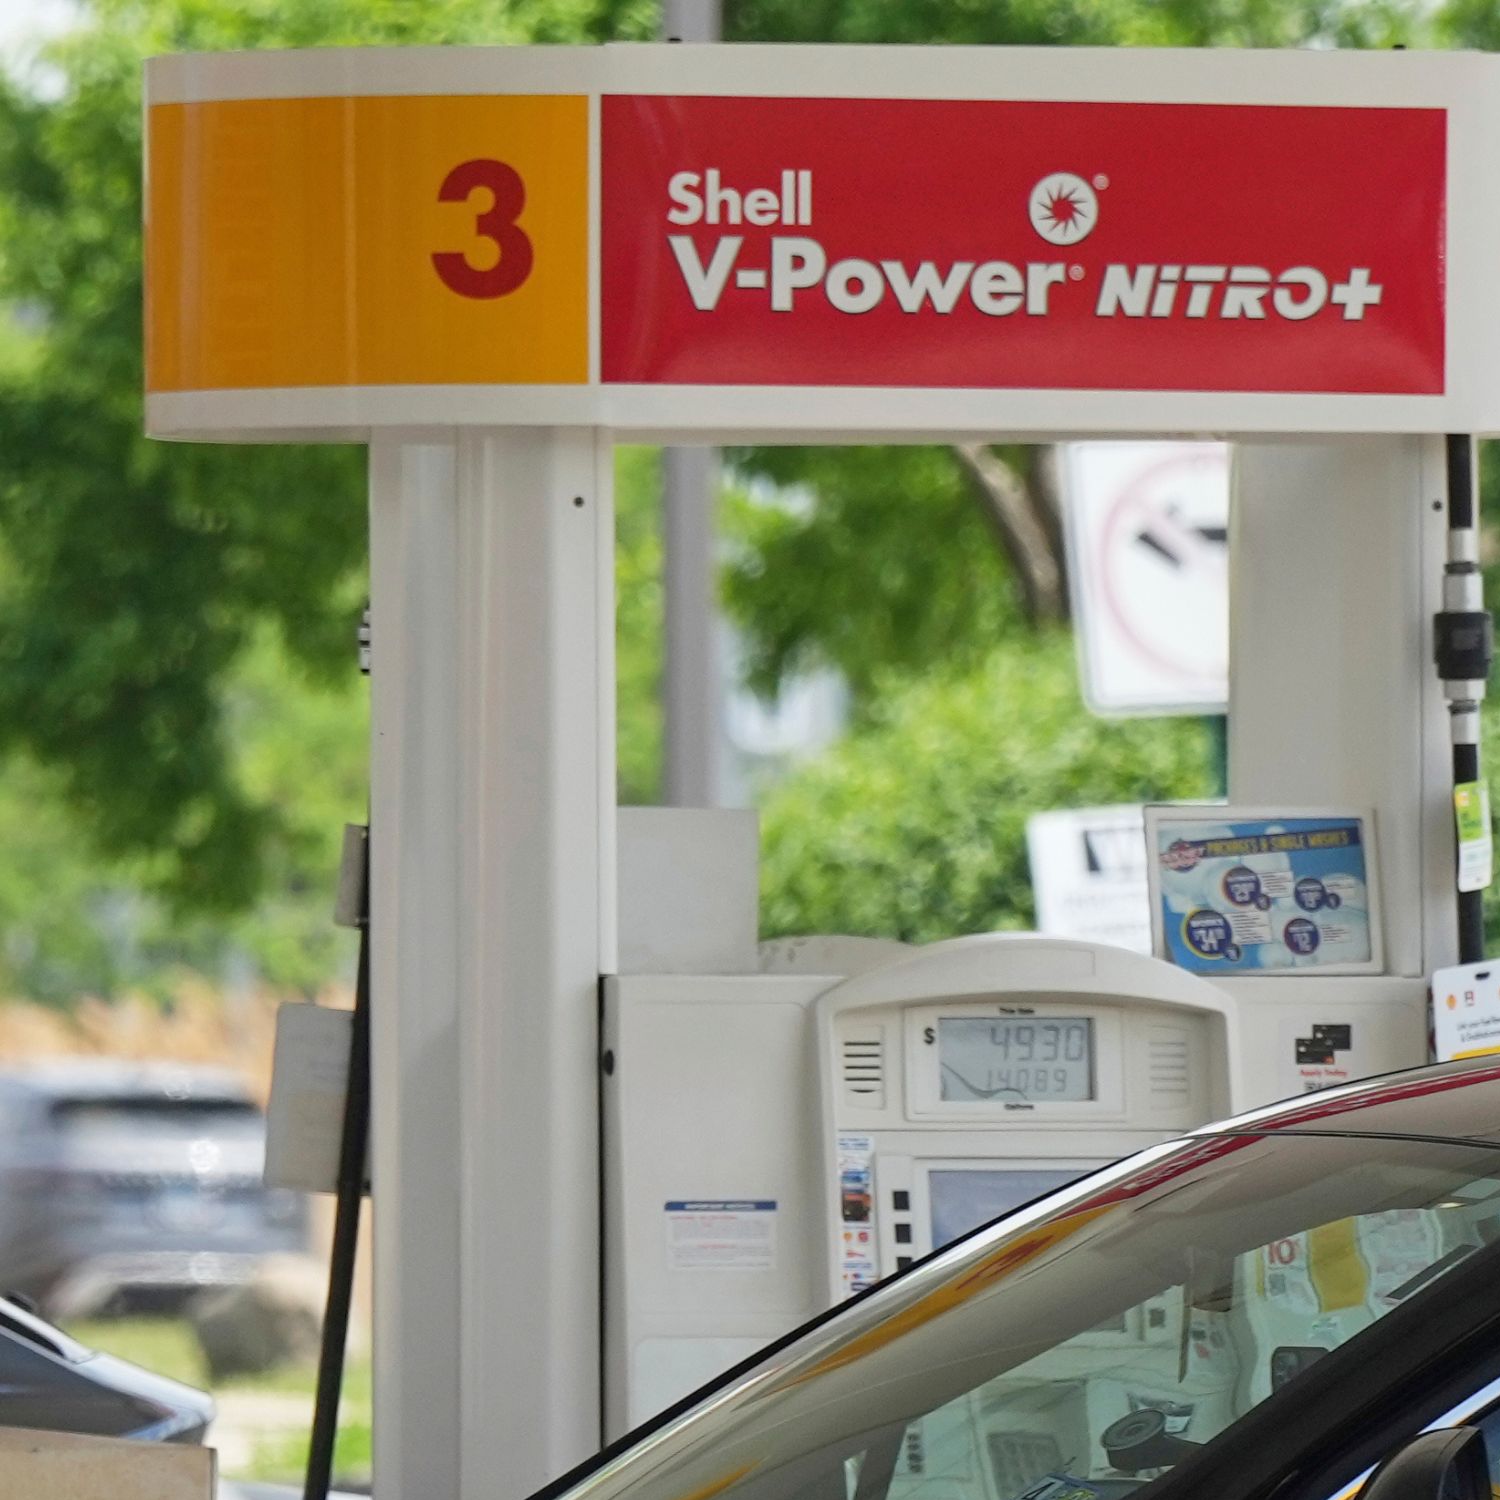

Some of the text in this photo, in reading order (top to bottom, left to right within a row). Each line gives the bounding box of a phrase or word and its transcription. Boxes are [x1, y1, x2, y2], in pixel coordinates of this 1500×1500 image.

[431, 158, 534, 300] 3
[667, 169, 812, 226] Shell
[666, 235, 1066, 316] V-Power
[923, 1027, 936, 1045] $
